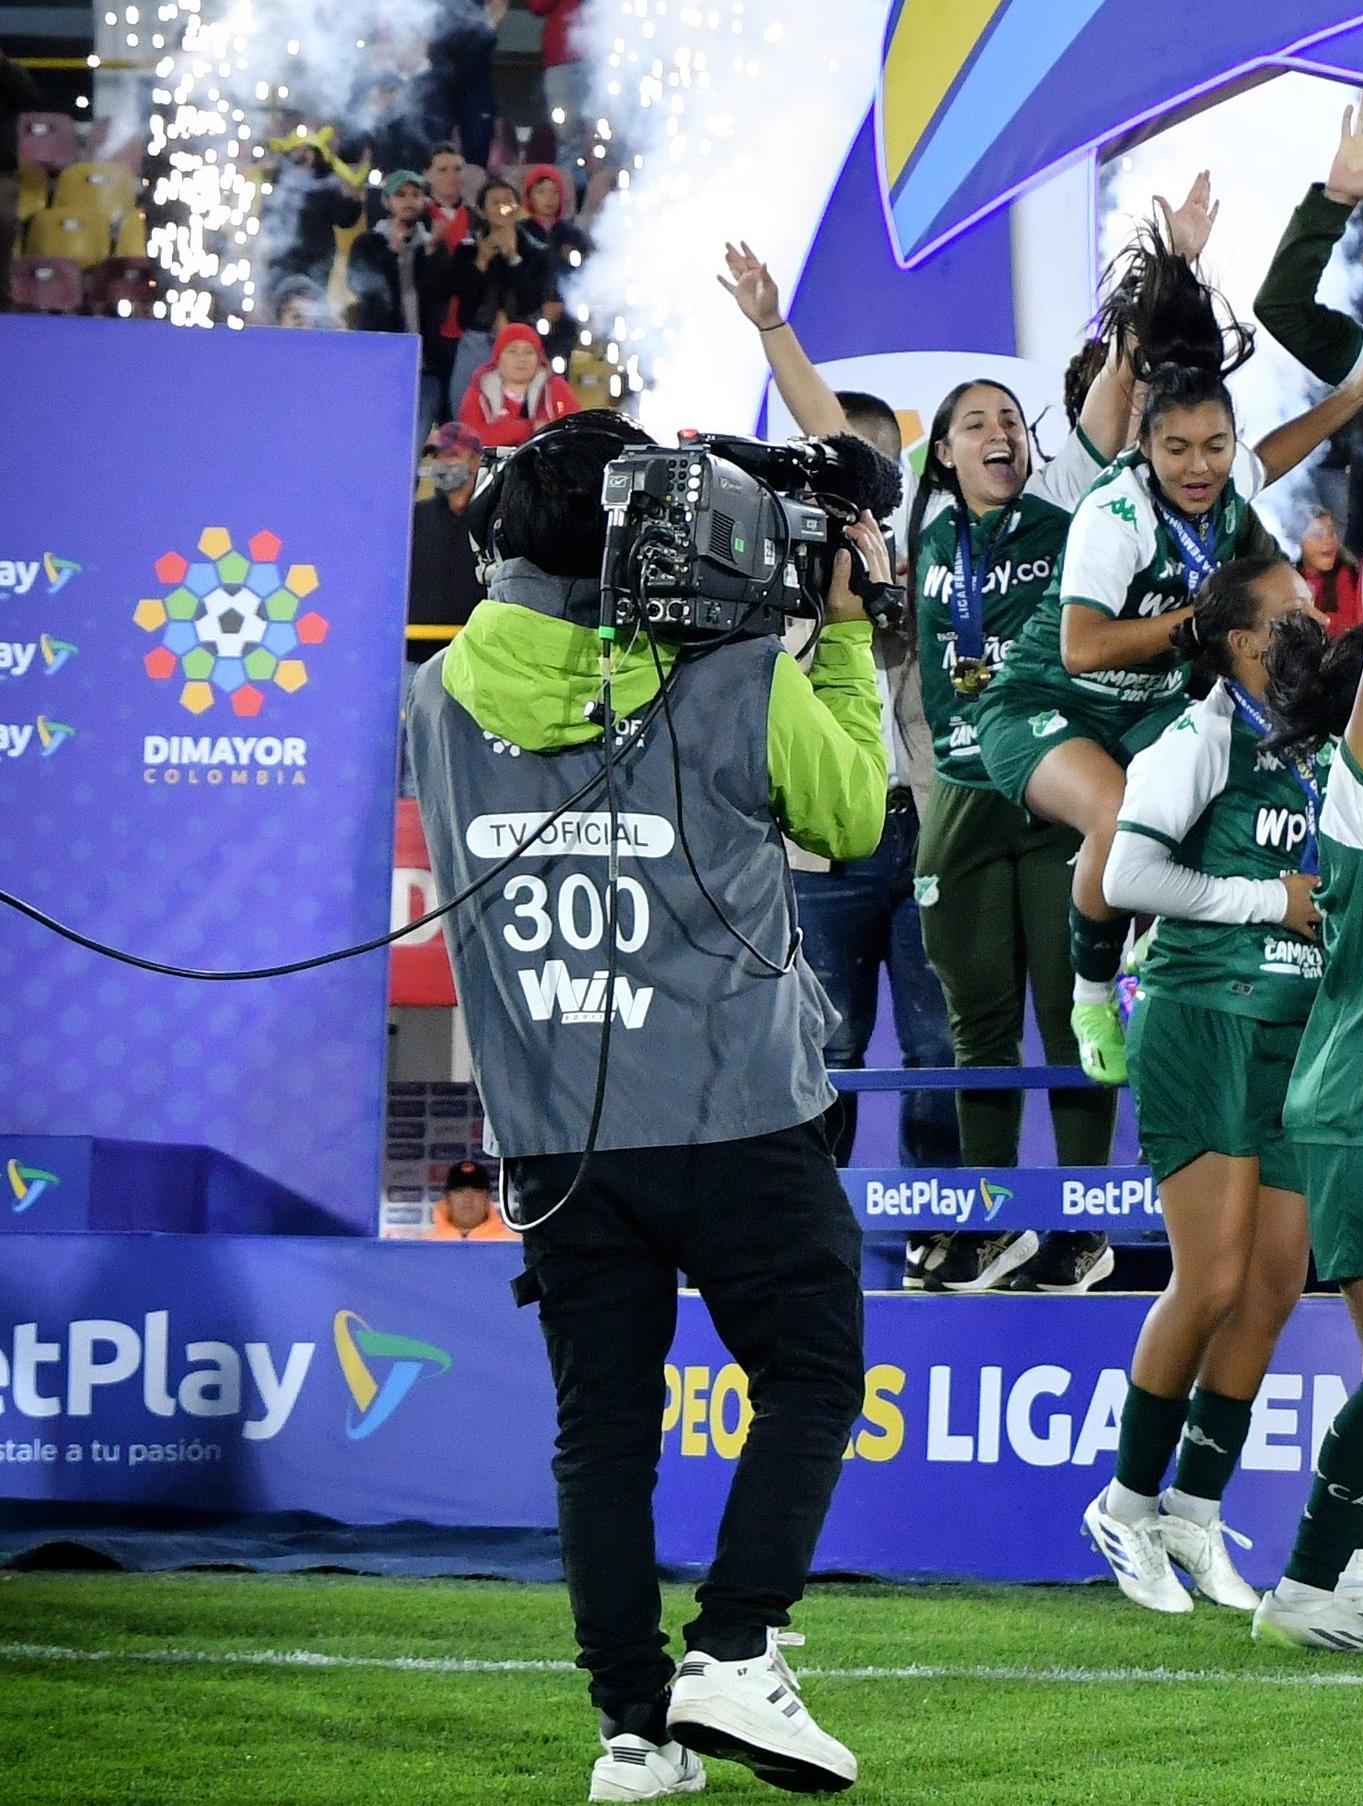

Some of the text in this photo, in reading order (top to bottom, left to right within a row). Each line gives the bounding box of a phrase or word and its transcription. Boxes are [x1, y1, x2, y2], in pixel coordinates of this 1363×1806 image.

[143, 736, 308, 765] DIMAYOR
[143, 768, 307, 785] COLOMBIA
[489, 821, 649, 847] TV OFICIAL
[503, 873, 650, 953] 300
[866, 1180, 977, 1223] BetPlay
[0, 1310, 317, 1440] tPlay
[927, 1364, 1130, 1466] LIGA
[65, 1444, 84, 1463] a
[91, 1440, 121, 1464] tu
[128, 1437, 222, 1467] pasión
